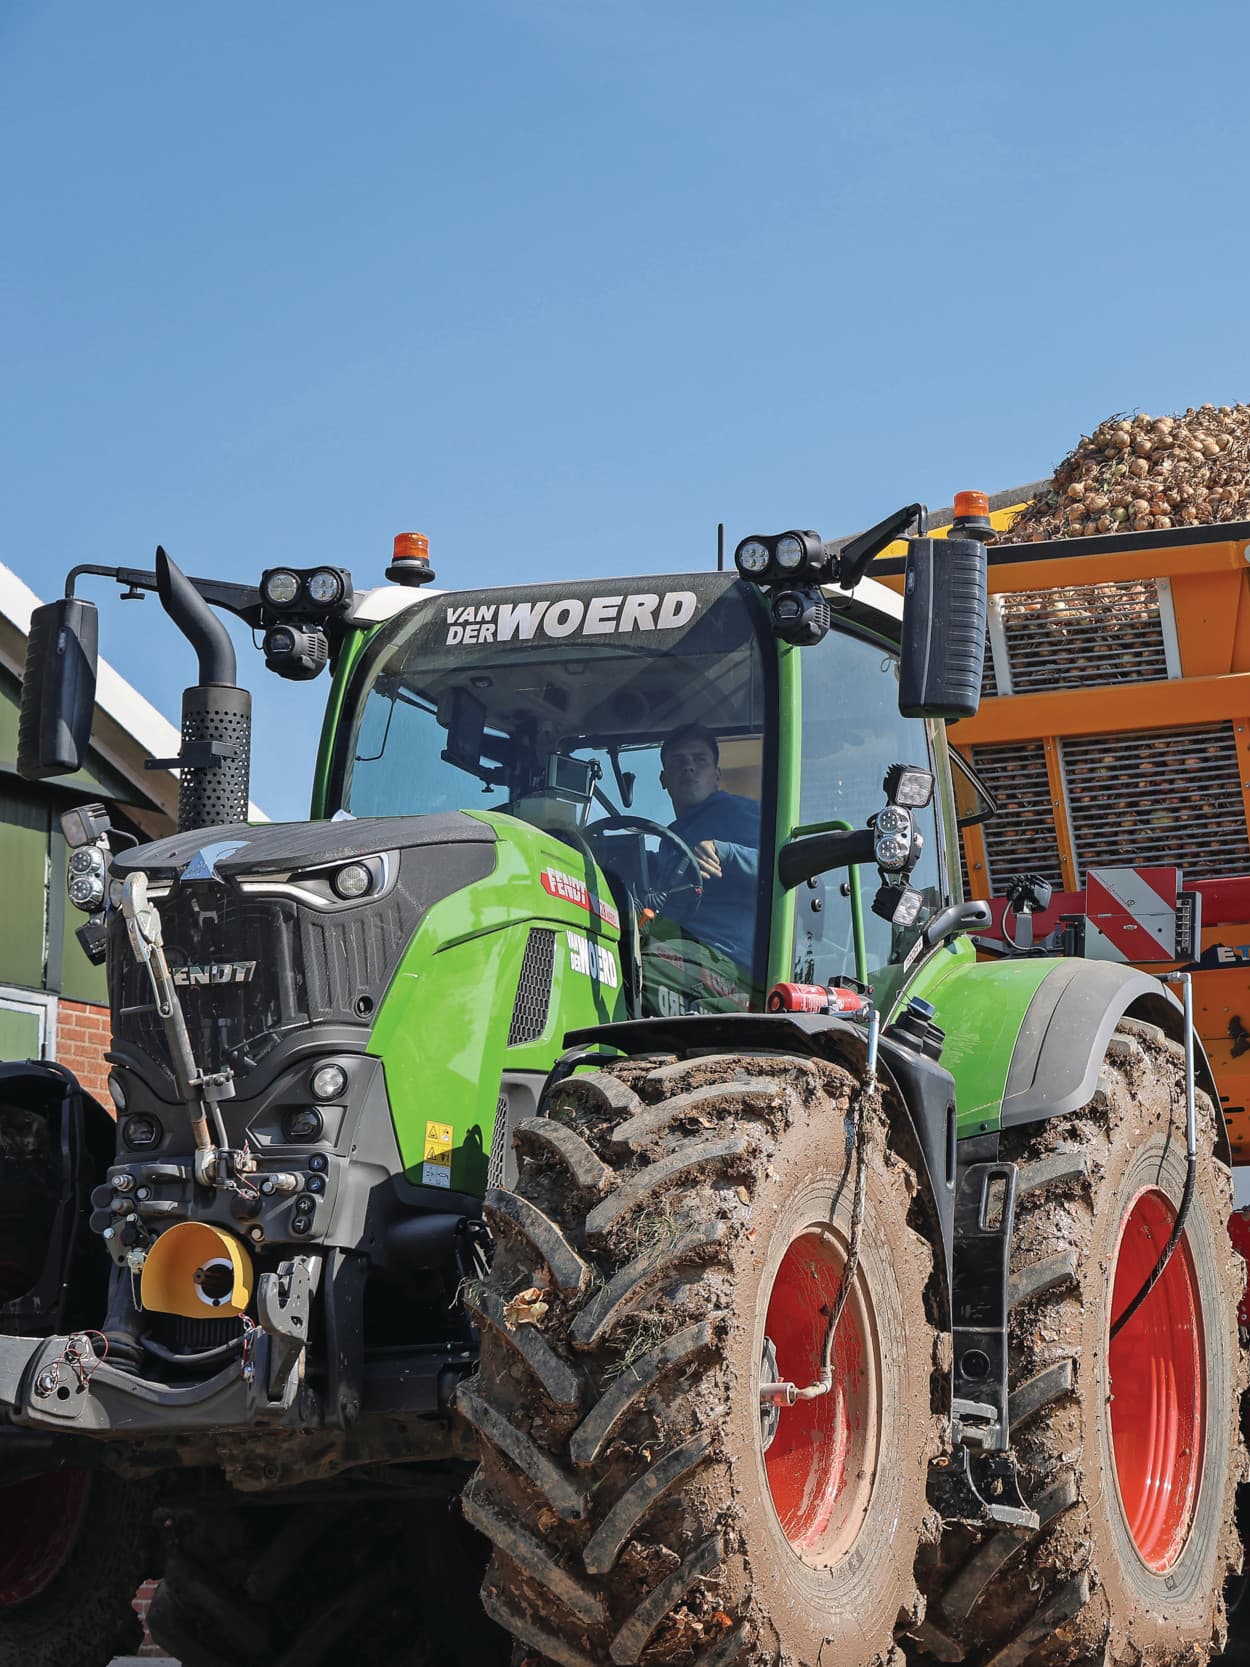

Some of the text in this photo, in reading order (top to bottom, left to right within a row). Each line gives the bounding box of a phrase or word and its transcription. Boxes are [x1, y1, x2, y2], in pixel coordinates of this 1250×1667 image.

[446, 604, 496, 624] VAN
[496, 591, 697, 642] WOERD
[446, 623, 496, 645] DER
[546, 866, 586, 905] FENDT
[168, 961, 257, 986] ENDT
[578, 934, 618, 989] WOERD
